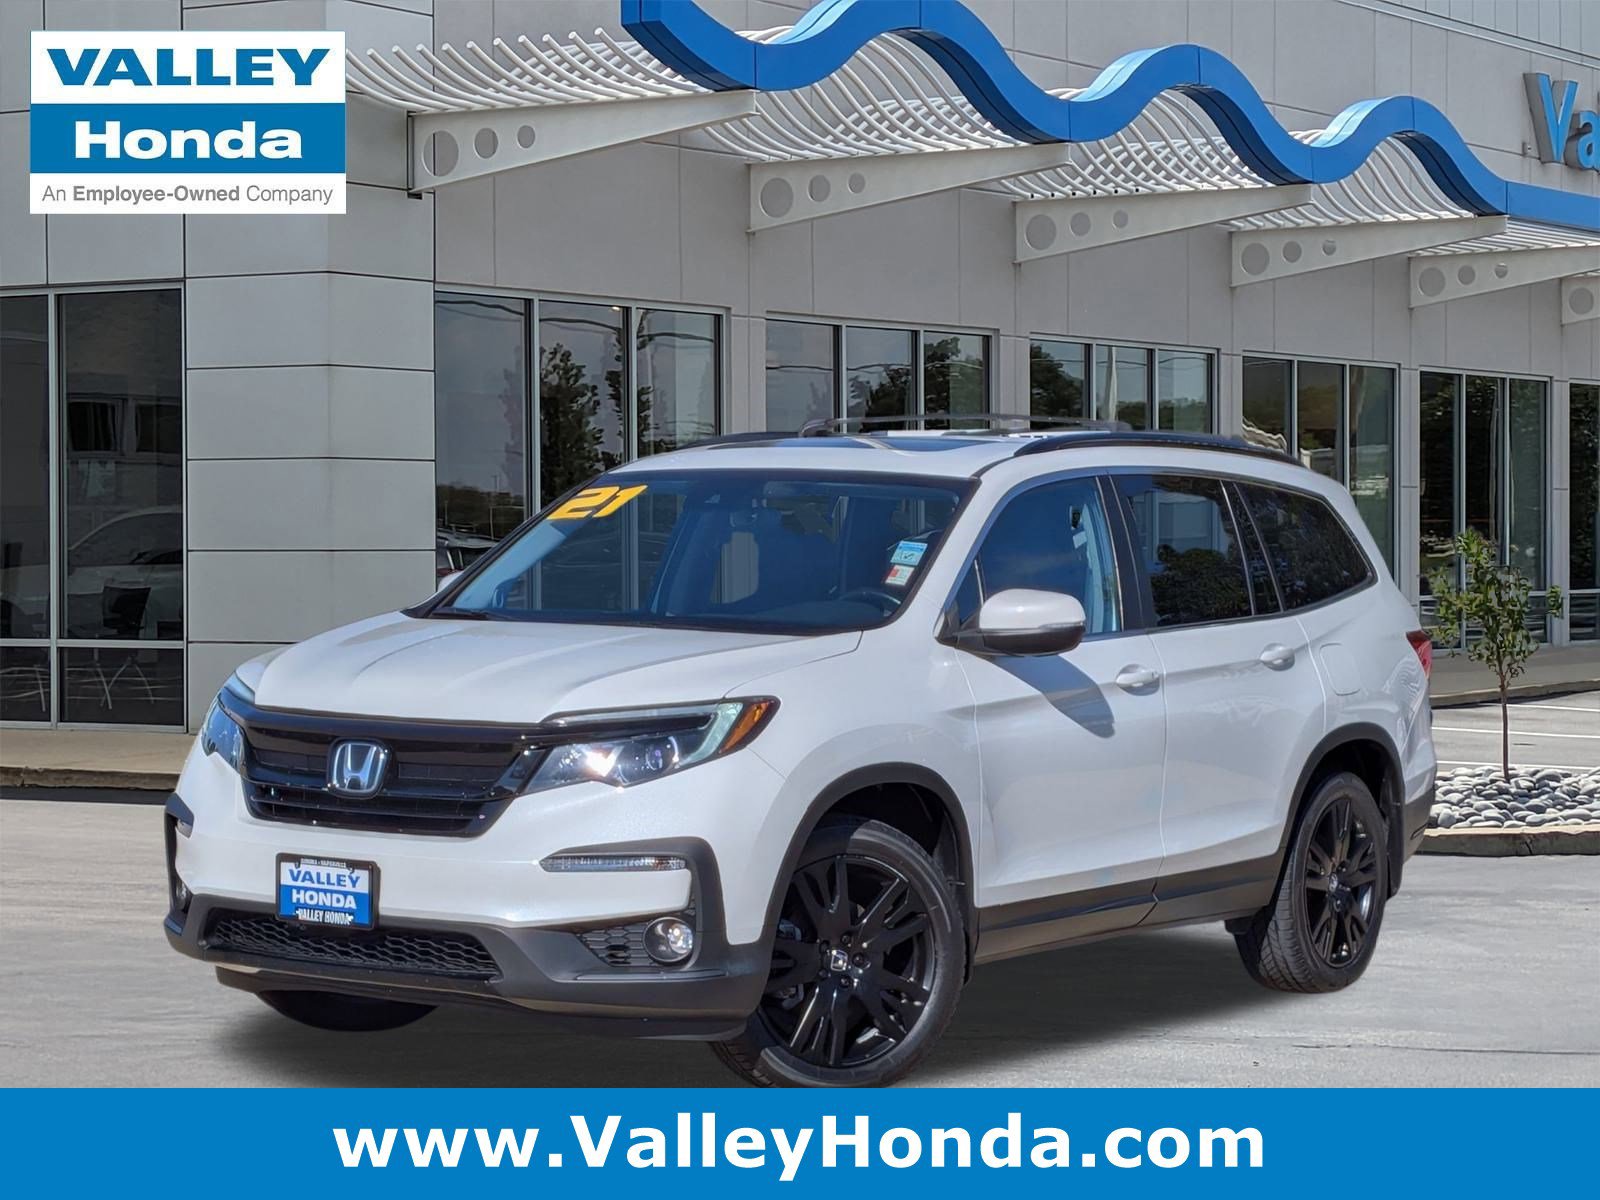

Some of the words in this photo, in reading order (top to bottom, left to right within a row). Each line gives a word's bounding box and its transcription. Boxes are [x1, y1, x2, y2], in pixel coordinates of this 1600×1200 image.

[546, 484, 648, 520] 21
[288, 869, 360, 889] VALLEY
[291, 889, 357, 909] HONDA
